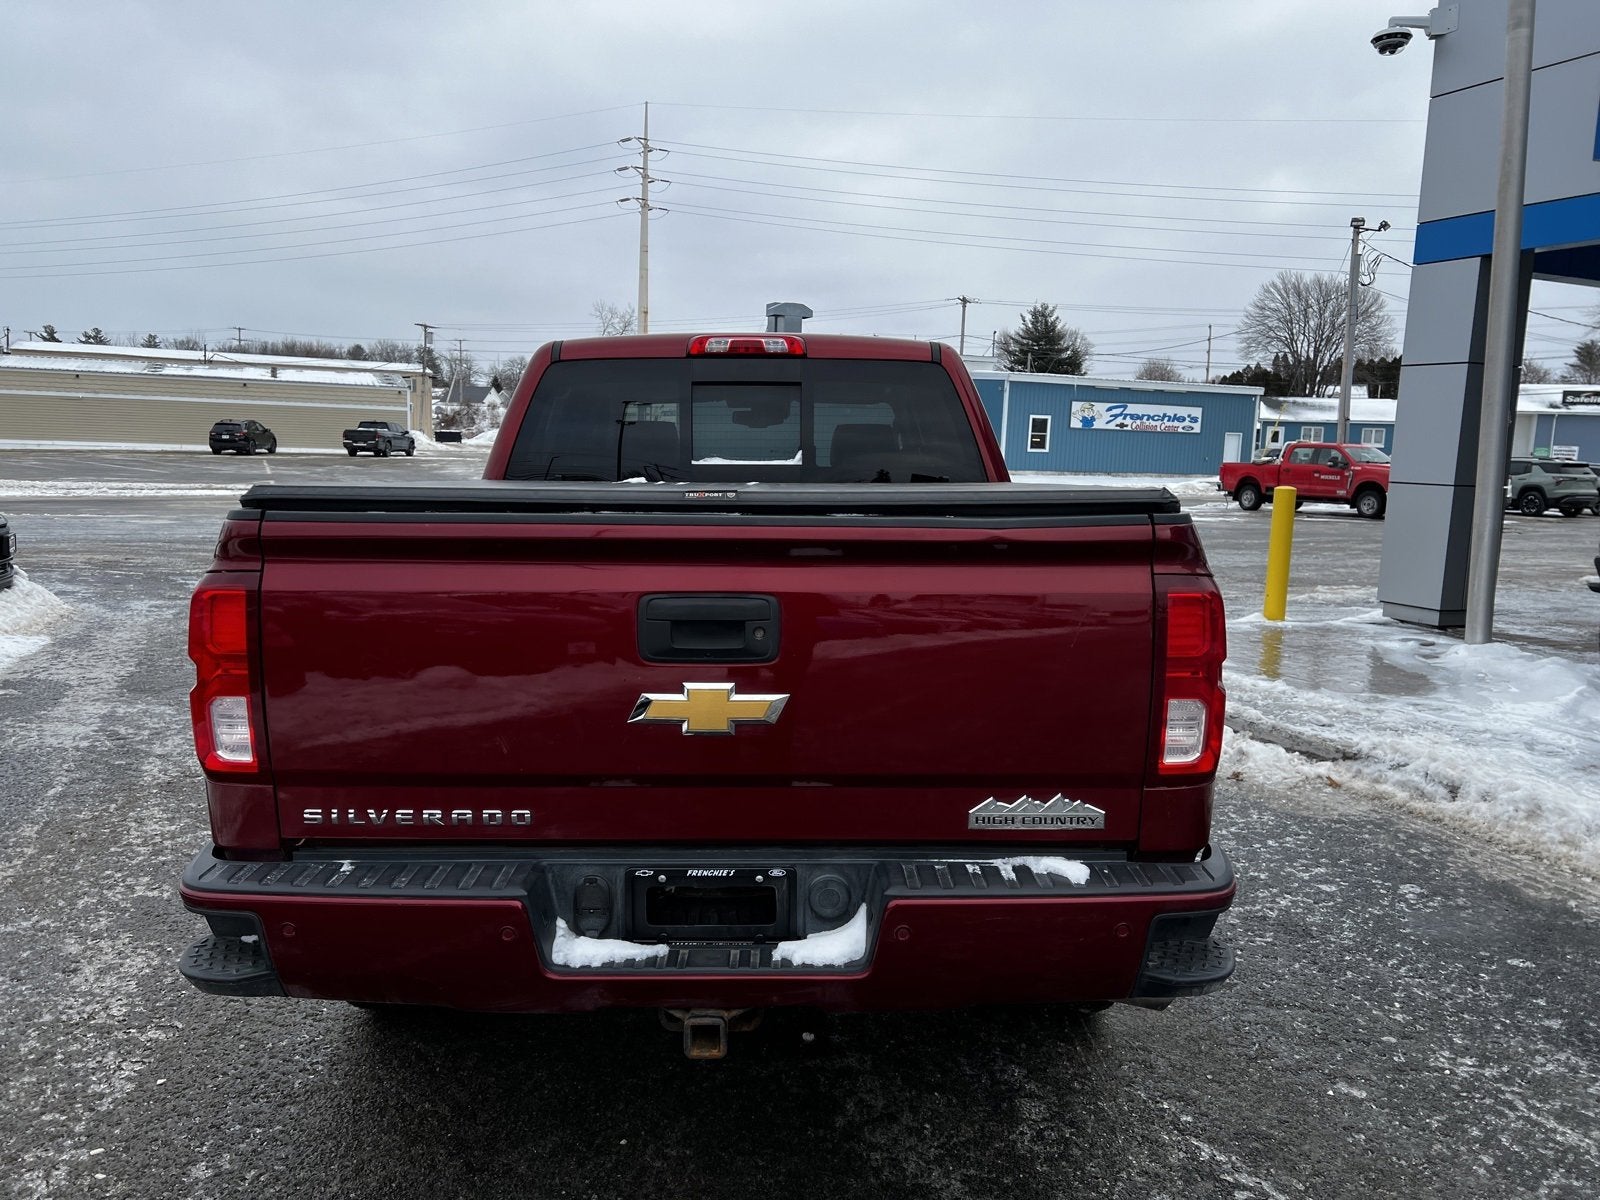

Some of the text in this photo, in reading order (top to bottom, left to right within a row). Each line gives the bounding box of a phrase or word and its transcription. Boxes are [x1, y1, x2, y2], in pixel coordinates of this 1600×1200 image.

[1105, 404, 1199, 424] Frenchie's
[1130, 421, 1180, 432] Collision Center
[303, 808, 533, 826] SILVERADO
[975, 816, 1099, 825] HIGH COUNTRY
[686, 869, 735, 877] FRENCHIE'S
